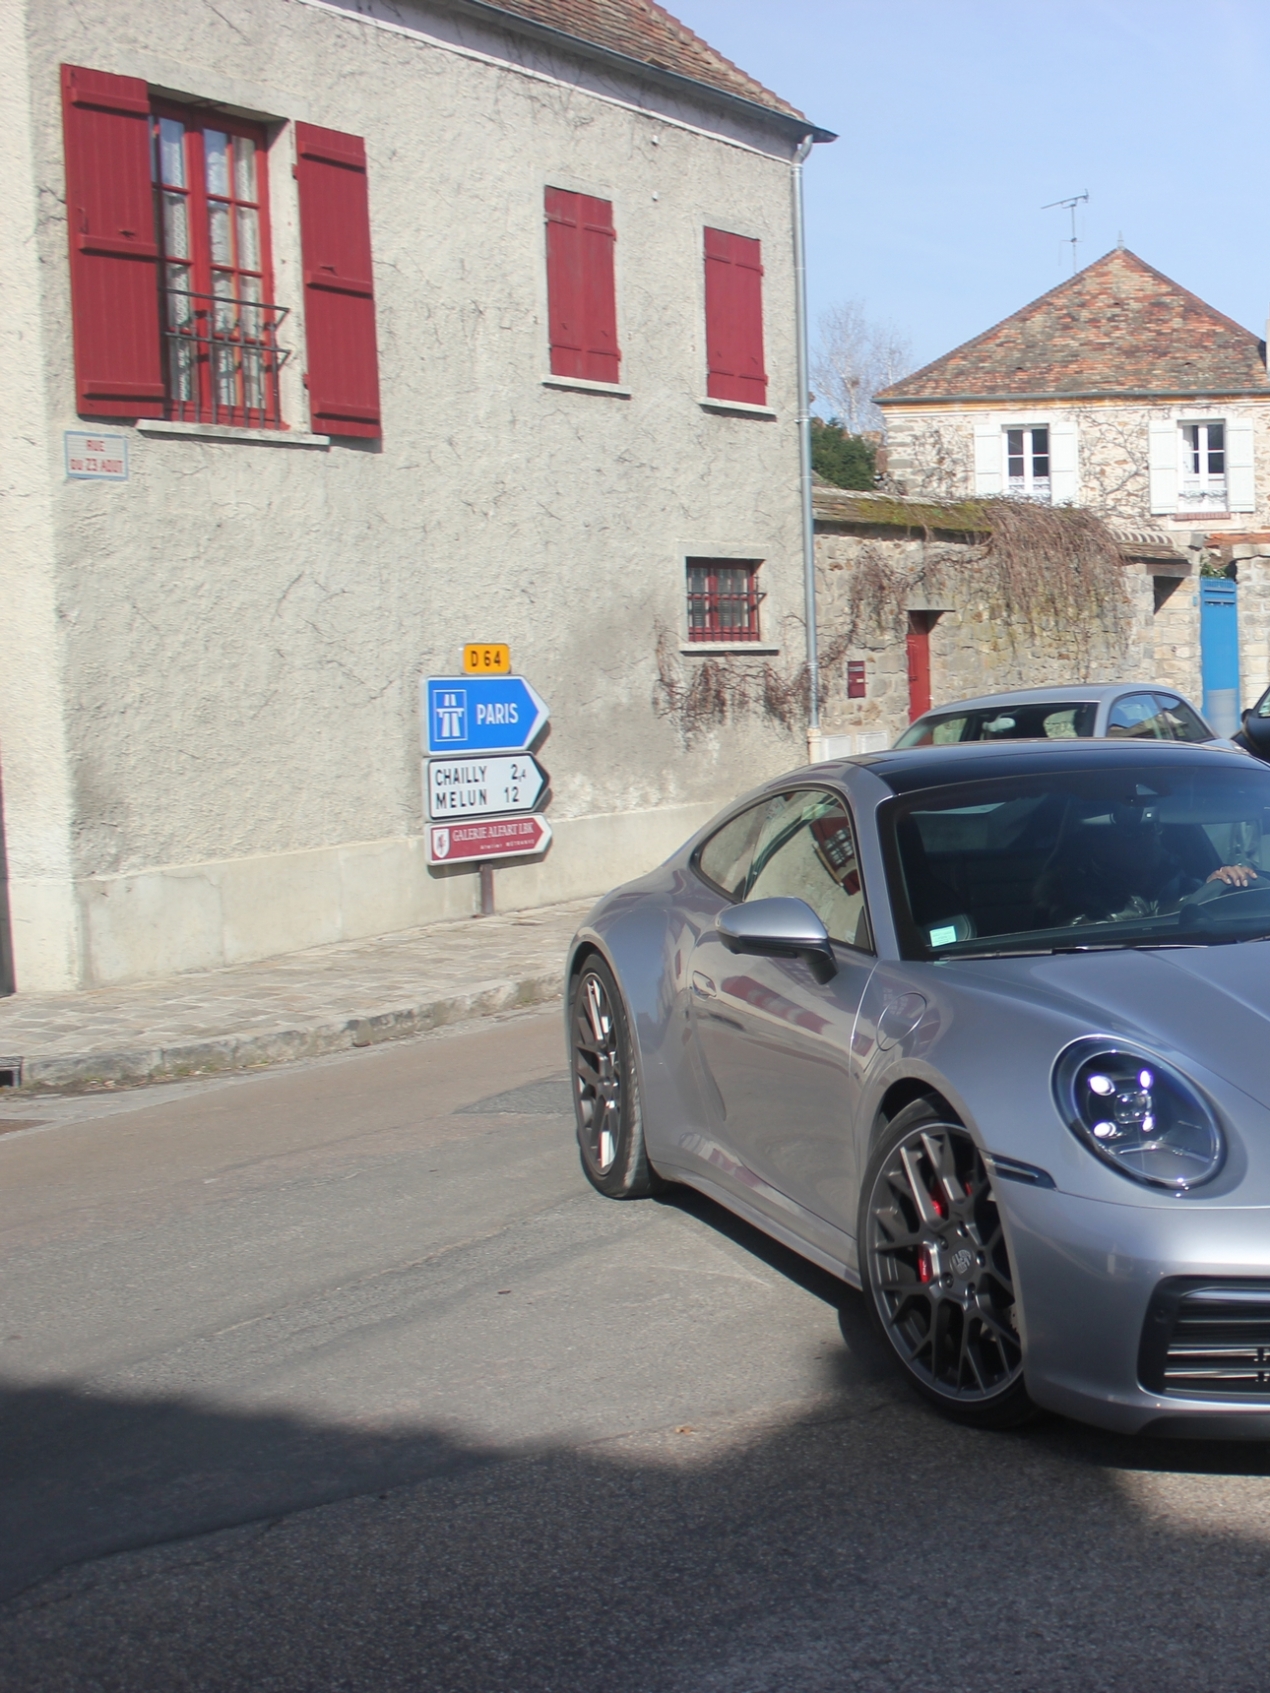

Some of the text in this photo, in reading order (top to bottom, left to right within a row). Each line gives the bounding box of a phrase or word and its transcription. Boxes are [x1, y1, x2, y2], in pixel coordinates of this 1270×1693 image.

[86, 440, 105, 452] RUE
[470, 650, 502, 667] D 64
[476, 703, 519, 725] PARIS
[435, 765, 487, 786] CHAILLY
[436, 786, 519, 810] MELUN 12
[452, 827, 487, 842] GALERIE
